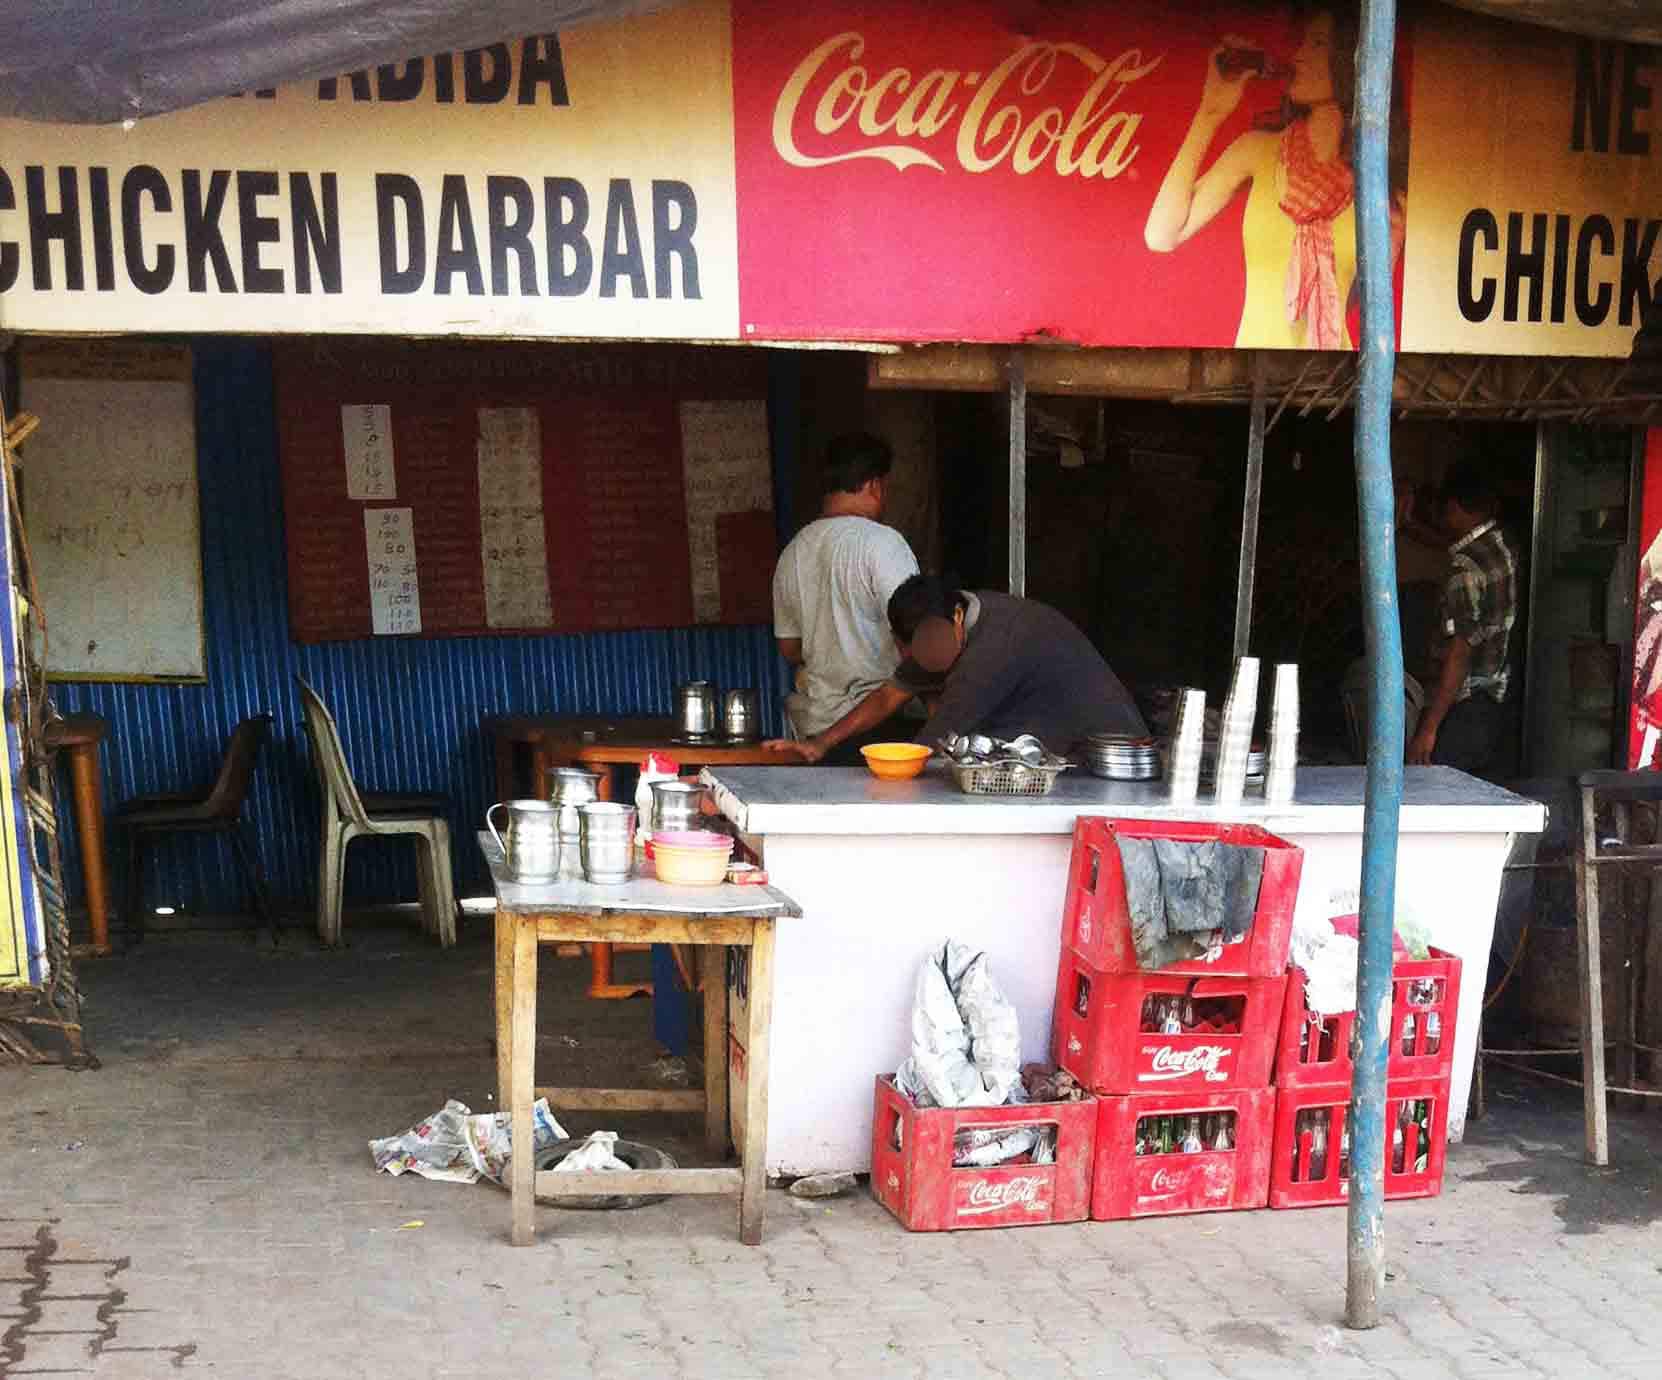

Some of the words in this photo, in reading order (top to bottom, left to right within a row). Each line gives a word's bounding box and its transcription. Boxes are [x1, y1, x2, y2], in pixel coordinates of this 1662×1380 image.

[773, 31, 1163, 180] Coca-Cola
[373, 172, 702, 301] DARBAR
[1456, 208, 1662, 327] CHICK
